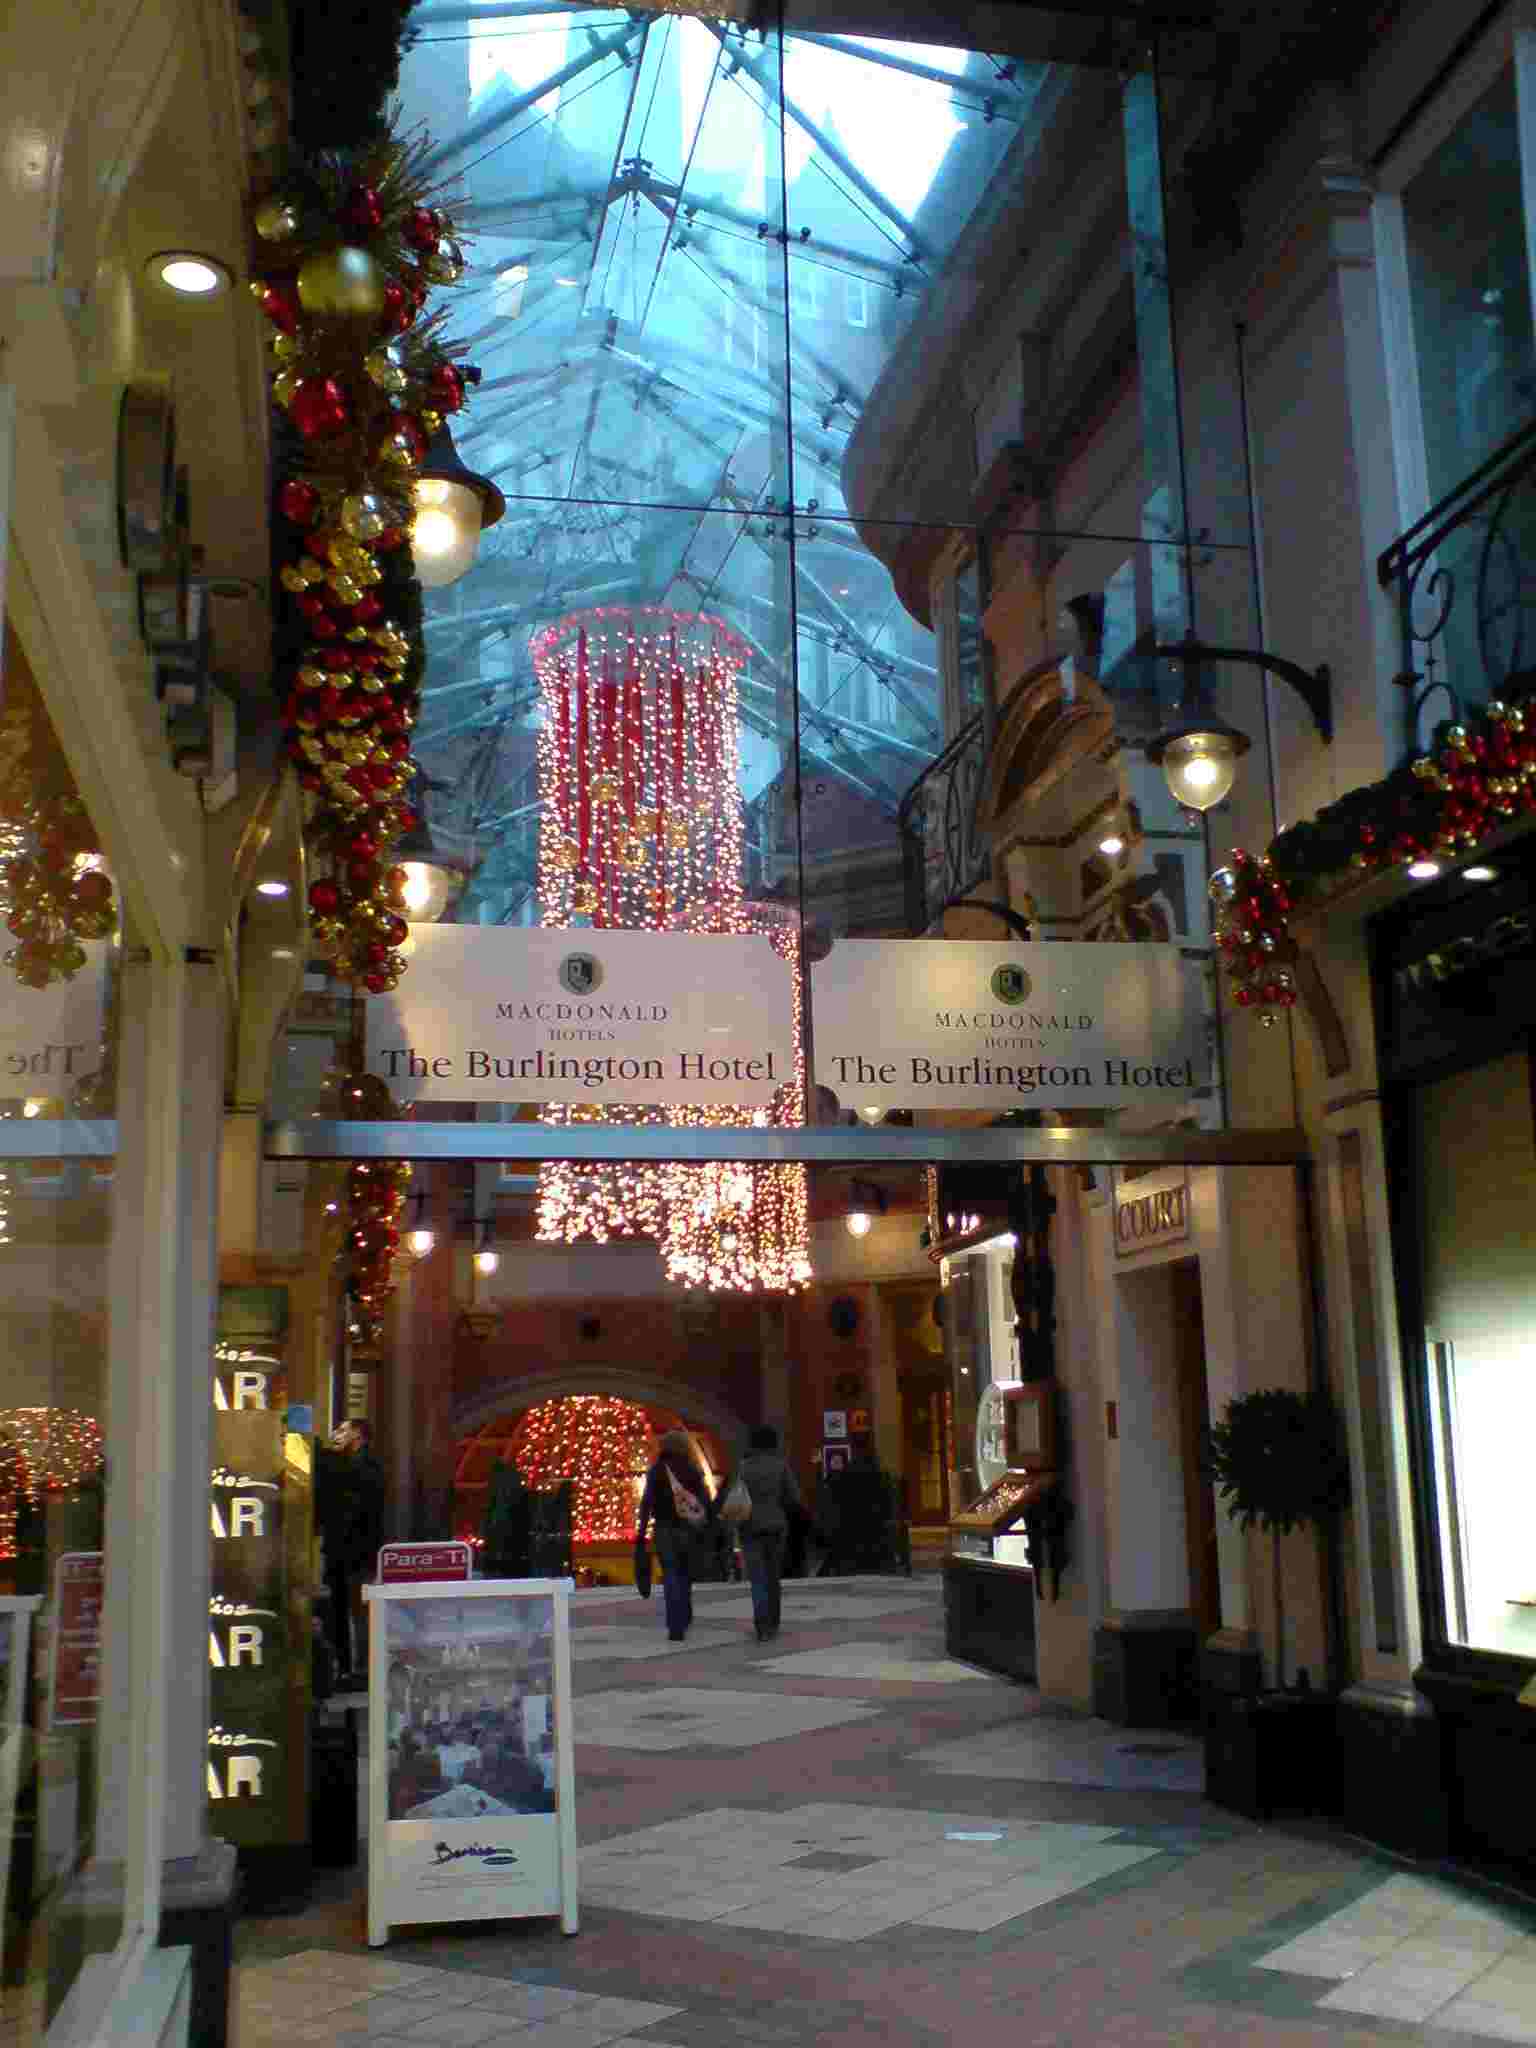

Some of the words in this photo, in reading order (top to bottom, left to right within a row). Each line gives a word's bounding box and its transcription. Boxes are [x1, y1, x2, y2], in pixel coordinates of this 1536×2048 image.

[496, 1002, 668, 1021] MACDONALD
[935, 1012, 1094, 1031] MACDONALD
[550, 1029, 615, 1041] HOTELS
[382, 1049, 452, 1080] The
[465, 1050, 664, 1086] Burlington
[679, 1051, 776, 1081] Hotel
[832, 1055, 896, 1084] The
[911, 1057, 1092, 1092] Burlington
[1105, 1059, 1193, 1088] Hotel
[1119, 1184, 1190, 1241] COURT
